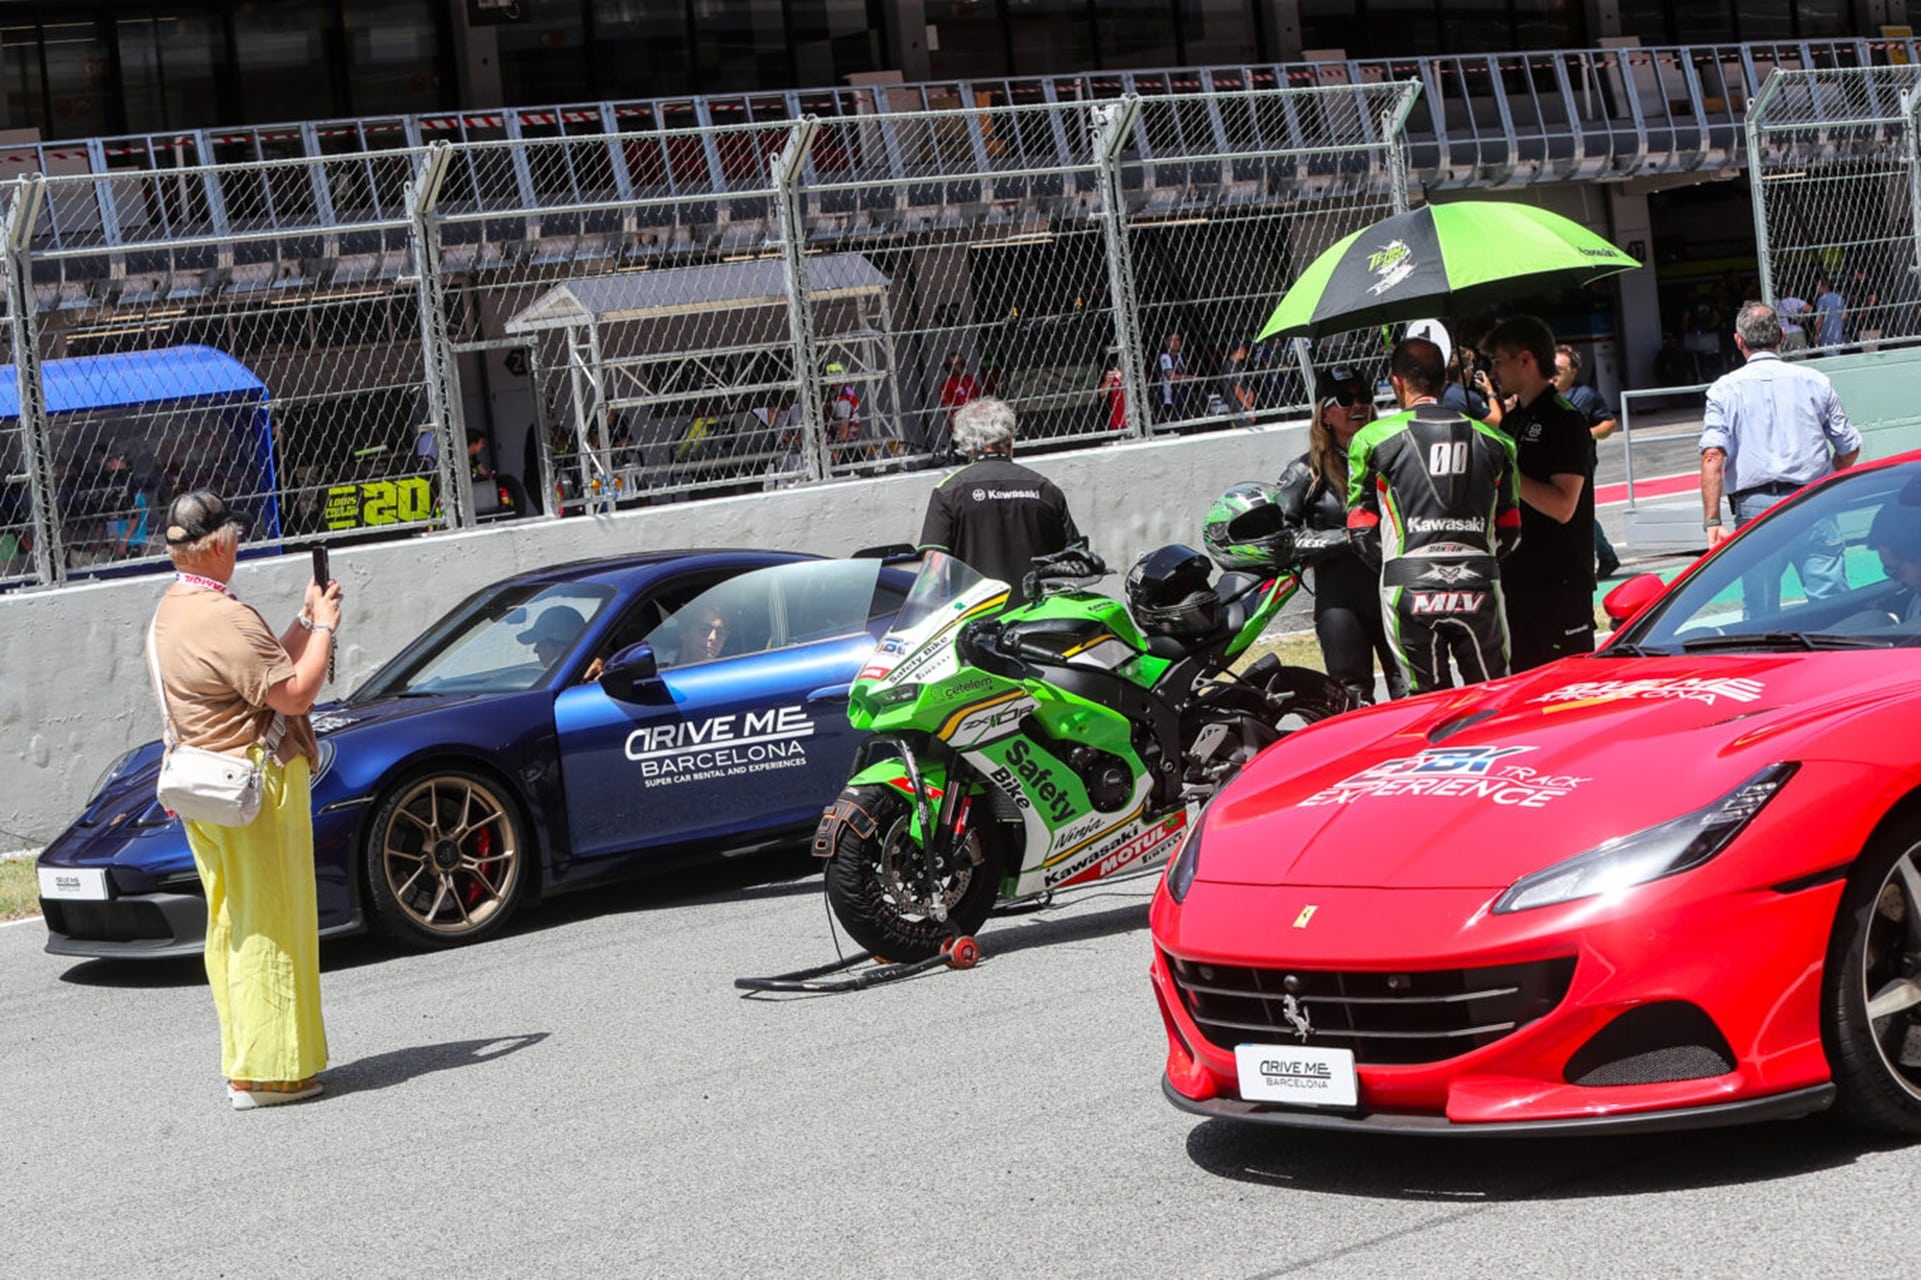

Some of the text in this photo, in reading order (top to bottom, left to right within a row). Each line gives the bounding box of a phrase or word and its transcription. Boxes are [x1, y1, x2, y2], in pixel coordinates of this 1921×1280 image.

[1429, 441, 1468, 476] 00
[360, 477, 431, 526] 20
[987, 489, 1040, 500] Kawasaki
[1407, 516, 1485, 533] Kawasaki
[889, 655, 923, 684] Safety
[923, 636, 948, 656] Bike
[945, 677, 993, 697] cetelem
[625, 705, 815, 760] DRIVE ME
[641, 740, 805, 777] BARCELONA
[645, 757, 807, 788] SUPER CAR RENTAL AND EXPERIENCES
[990, 765, 1030, 809] Bike
[1005, 740, 1077, 823] Safety
[1296, 776, 1568, 807] EXPERIENCE
[1497, 766, 1594, 788] TRACK
[1054, 818, 1105, 850] Ninja
[1044, 823, 1139, 887] Kawasaki
[1100, 826, 1168, 876] MOTUL
[1260, 1060, 1331, 1076] DRIVE ME
[1266, 1077, 1328, 1089] BARCELONA
